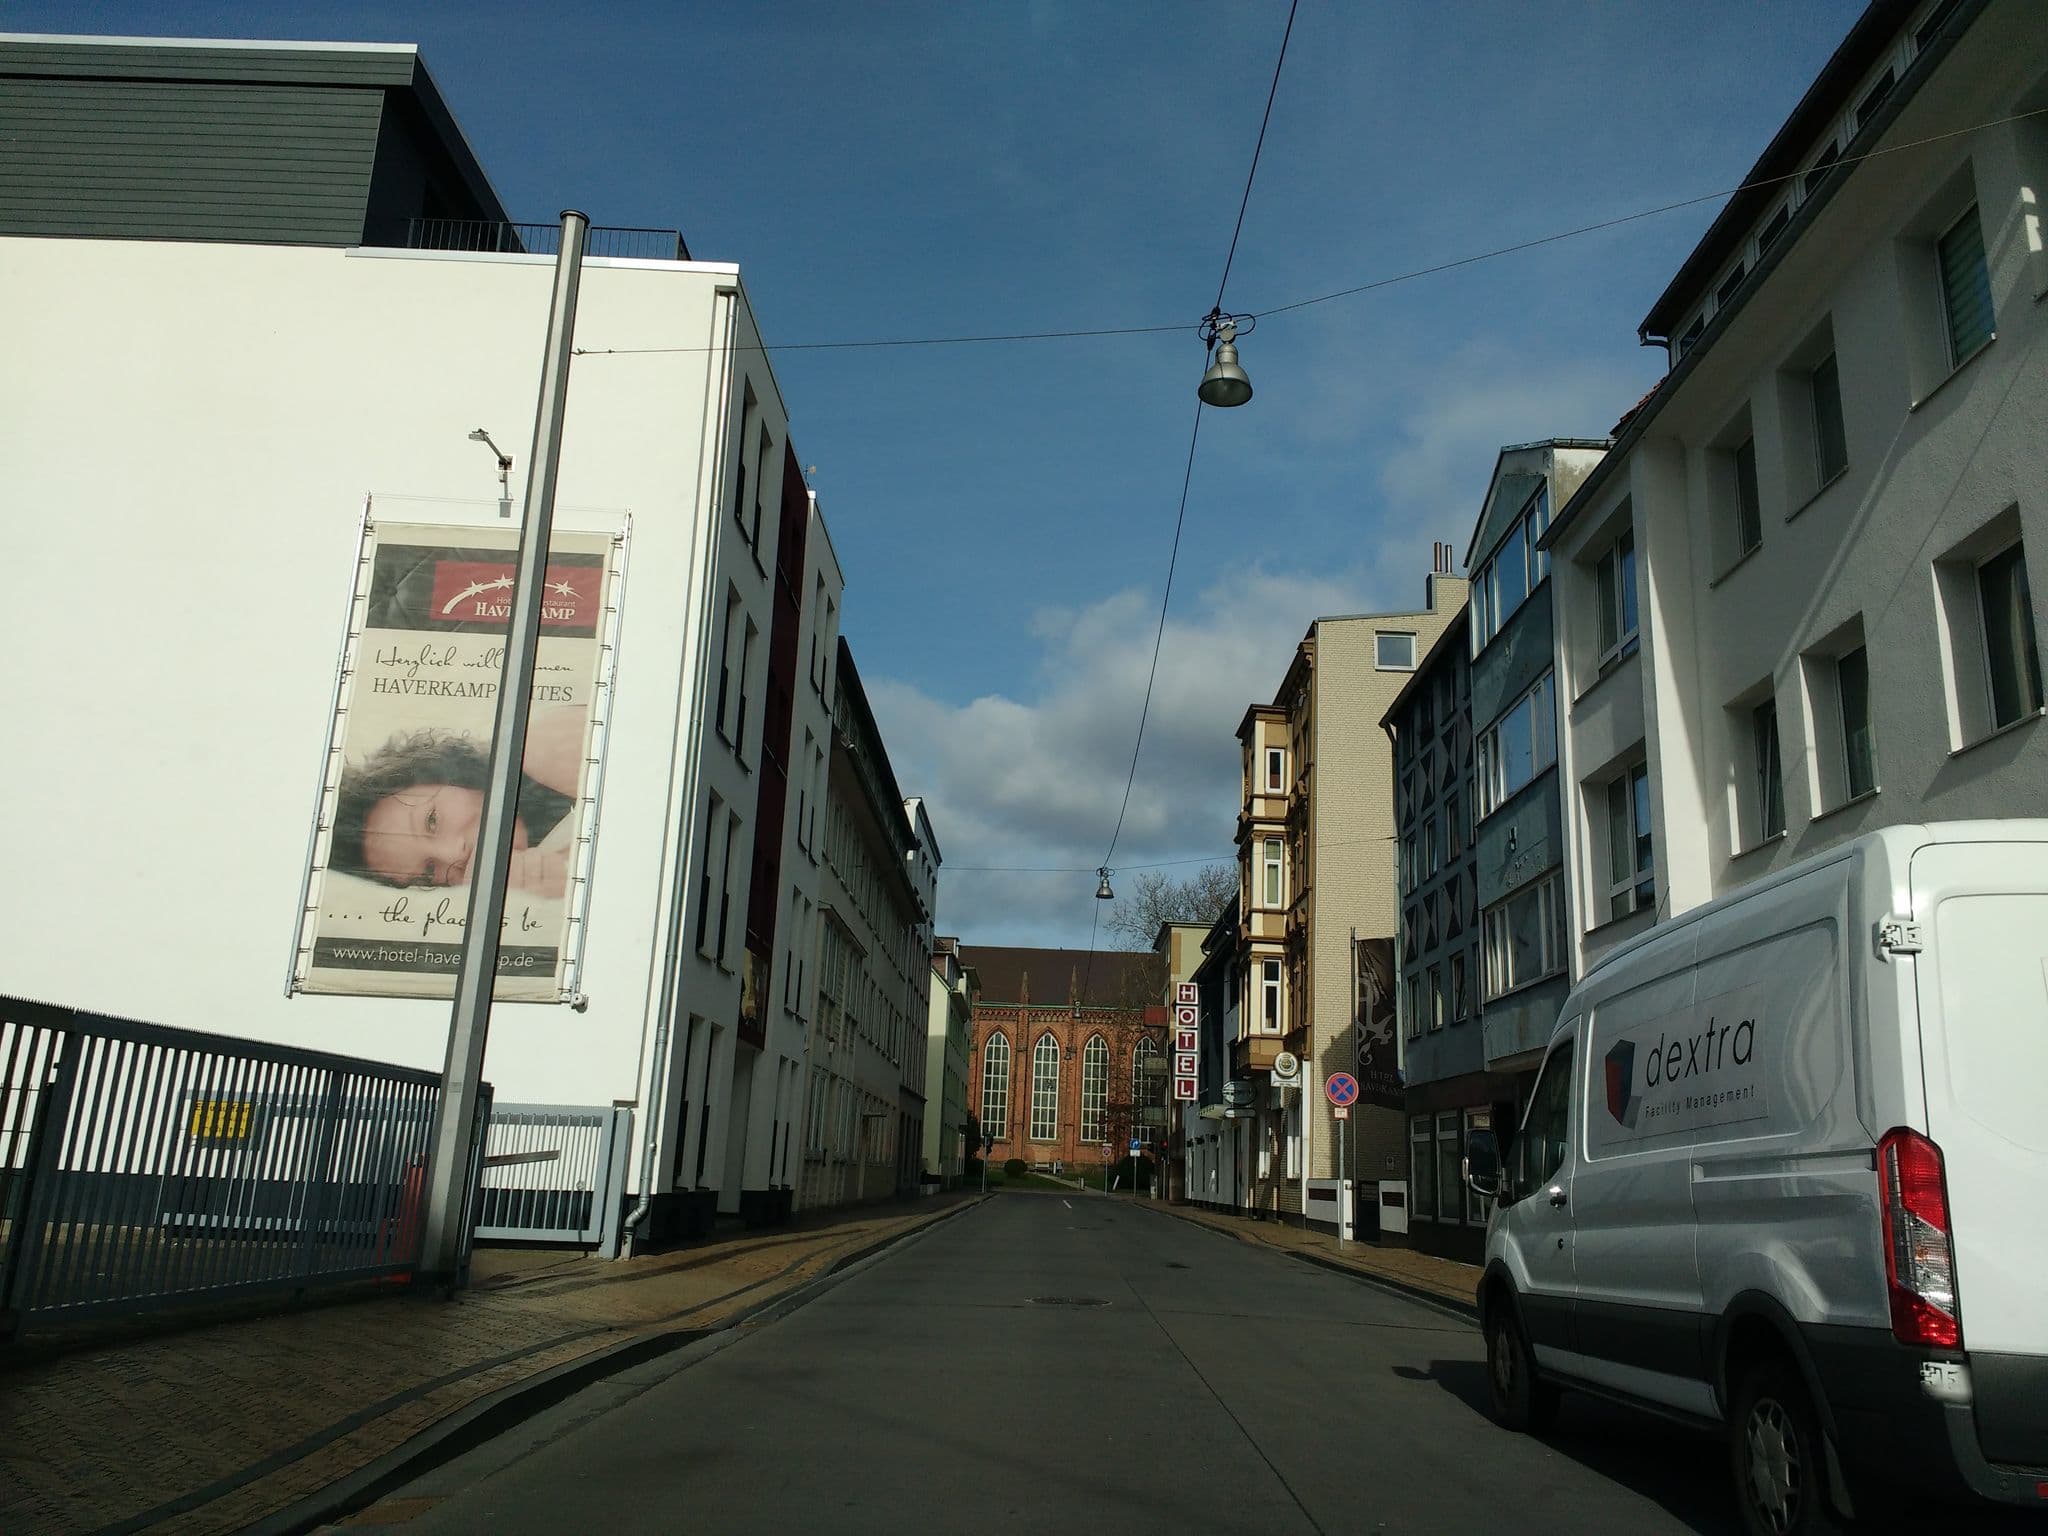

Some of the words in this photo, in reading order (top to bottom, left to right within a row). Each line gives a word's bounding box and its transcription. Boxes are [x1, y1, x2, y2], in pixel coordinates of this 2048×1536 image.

[376, 644, 457, 677] Herzlich
[372, 677, 497, 698] HAVERKAMP
[379, 896, 415, 924] the
[423, 898, 466, 936] plac
[522, 906, 543, 932] be
[333, 946, 534, 970] www.hotel-havep.de
[1179, 984, 1196, 1097] HOTEL
[1646, 1016, 1755, 1088] dextra
[1645, 1101, 1681, 1118] Facility
[1686, 1084, 1754, 1109] Management
